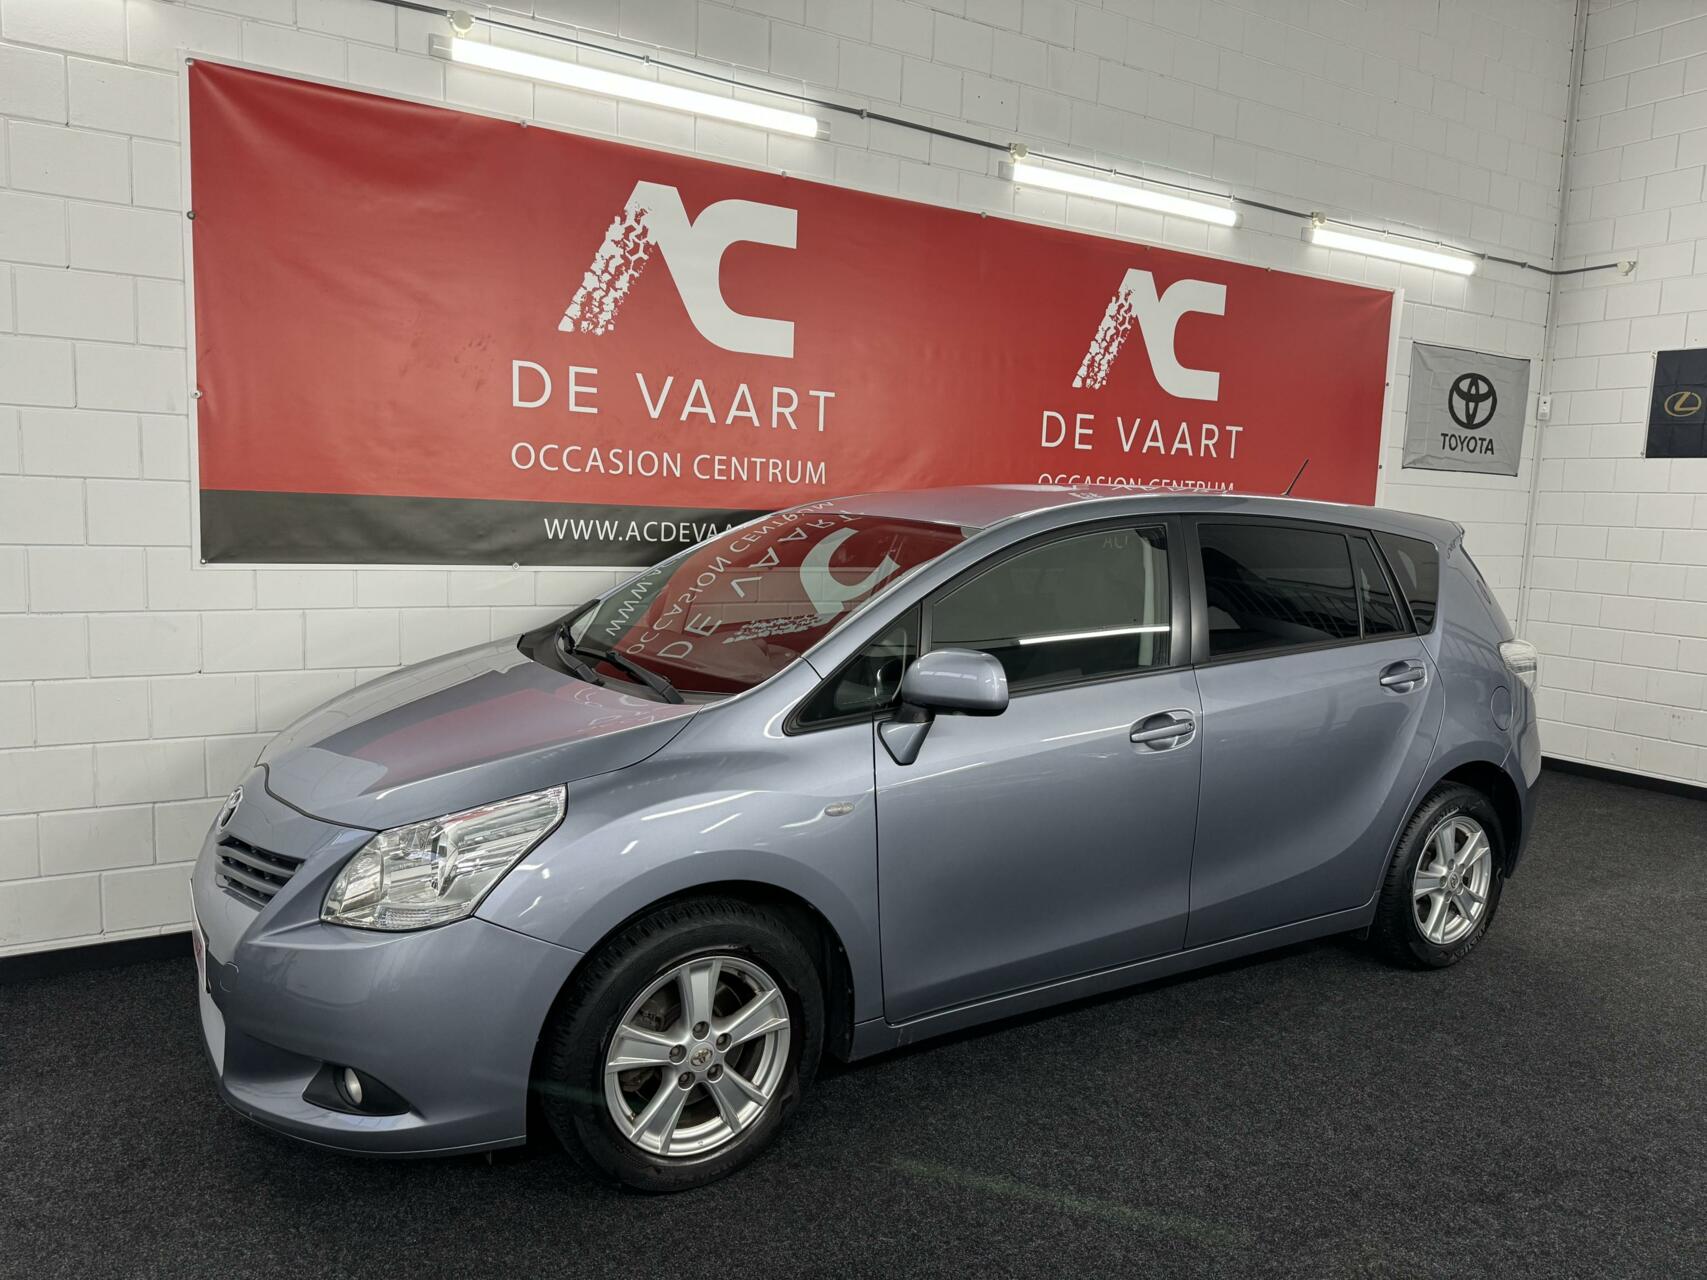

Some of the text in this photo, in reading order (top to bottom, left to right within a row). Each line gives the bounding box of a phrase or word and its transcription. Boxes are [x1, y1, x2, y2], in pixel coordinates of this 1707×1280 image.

[512, 359, 836, 432] DE VAART
[1041, 410, 1244, 459] DE VAART
[1440, 432, 1495, 456] TOYOTA
[511, 442, 827, 485] OCCASION CENTRUM
